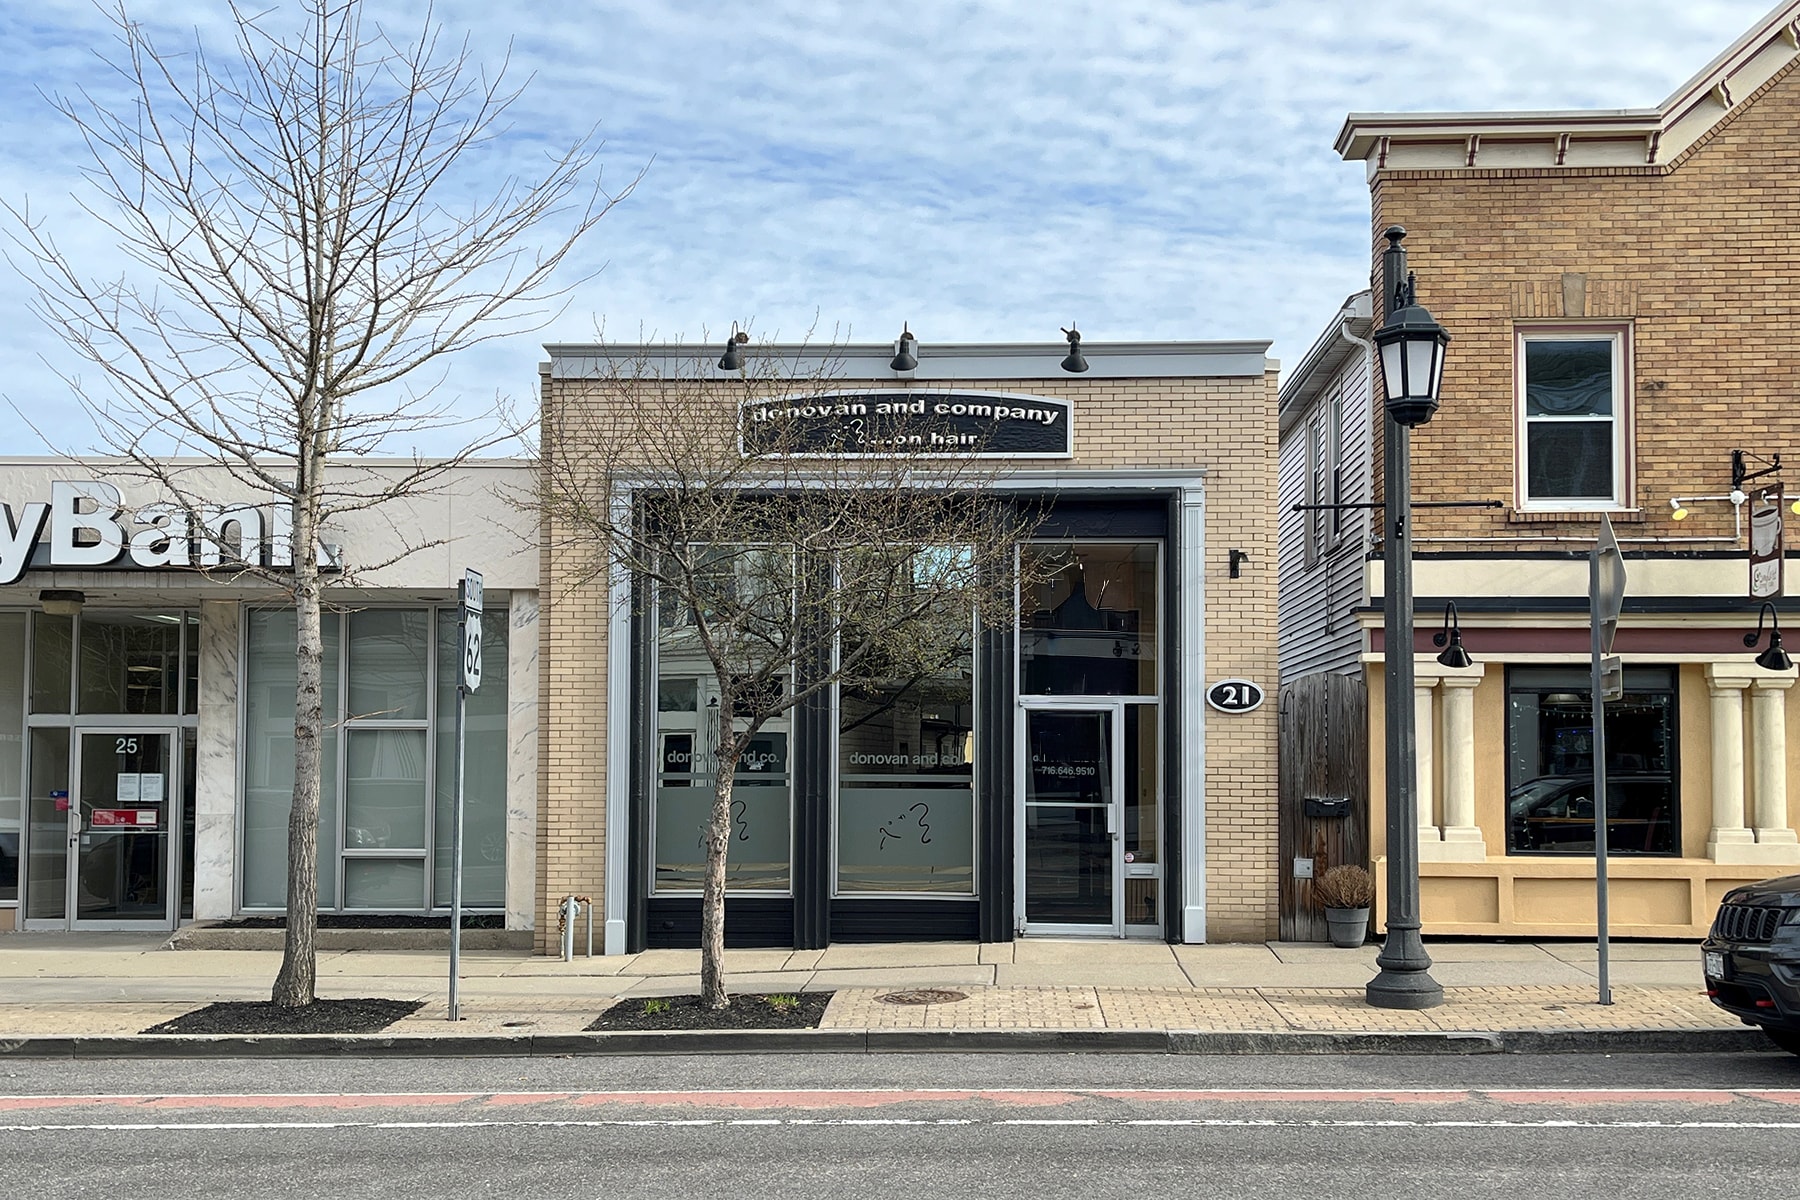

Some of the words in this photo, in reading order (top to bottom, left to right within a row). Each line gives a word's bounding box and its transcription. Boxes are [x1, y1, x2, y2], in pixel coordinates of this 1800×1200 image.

[753, 402, 867, 422] donovan
[876, 400, 925, 415] and
[934, 402, 1059, 424] company
[930, 433, 977, 445] hair
[466, 577, 482, 604] SOUTH
[466, 633, 480, 675] 62
[1222, 686, 1250, 705] 21
[115, 738, 138, 754] 25
[759, 752, 780, 763] co.
[849, 751, 909, 765] donovan
[912, 752, 938, 765] and
[1041, 766, 1096, 776] 716.646.9510
